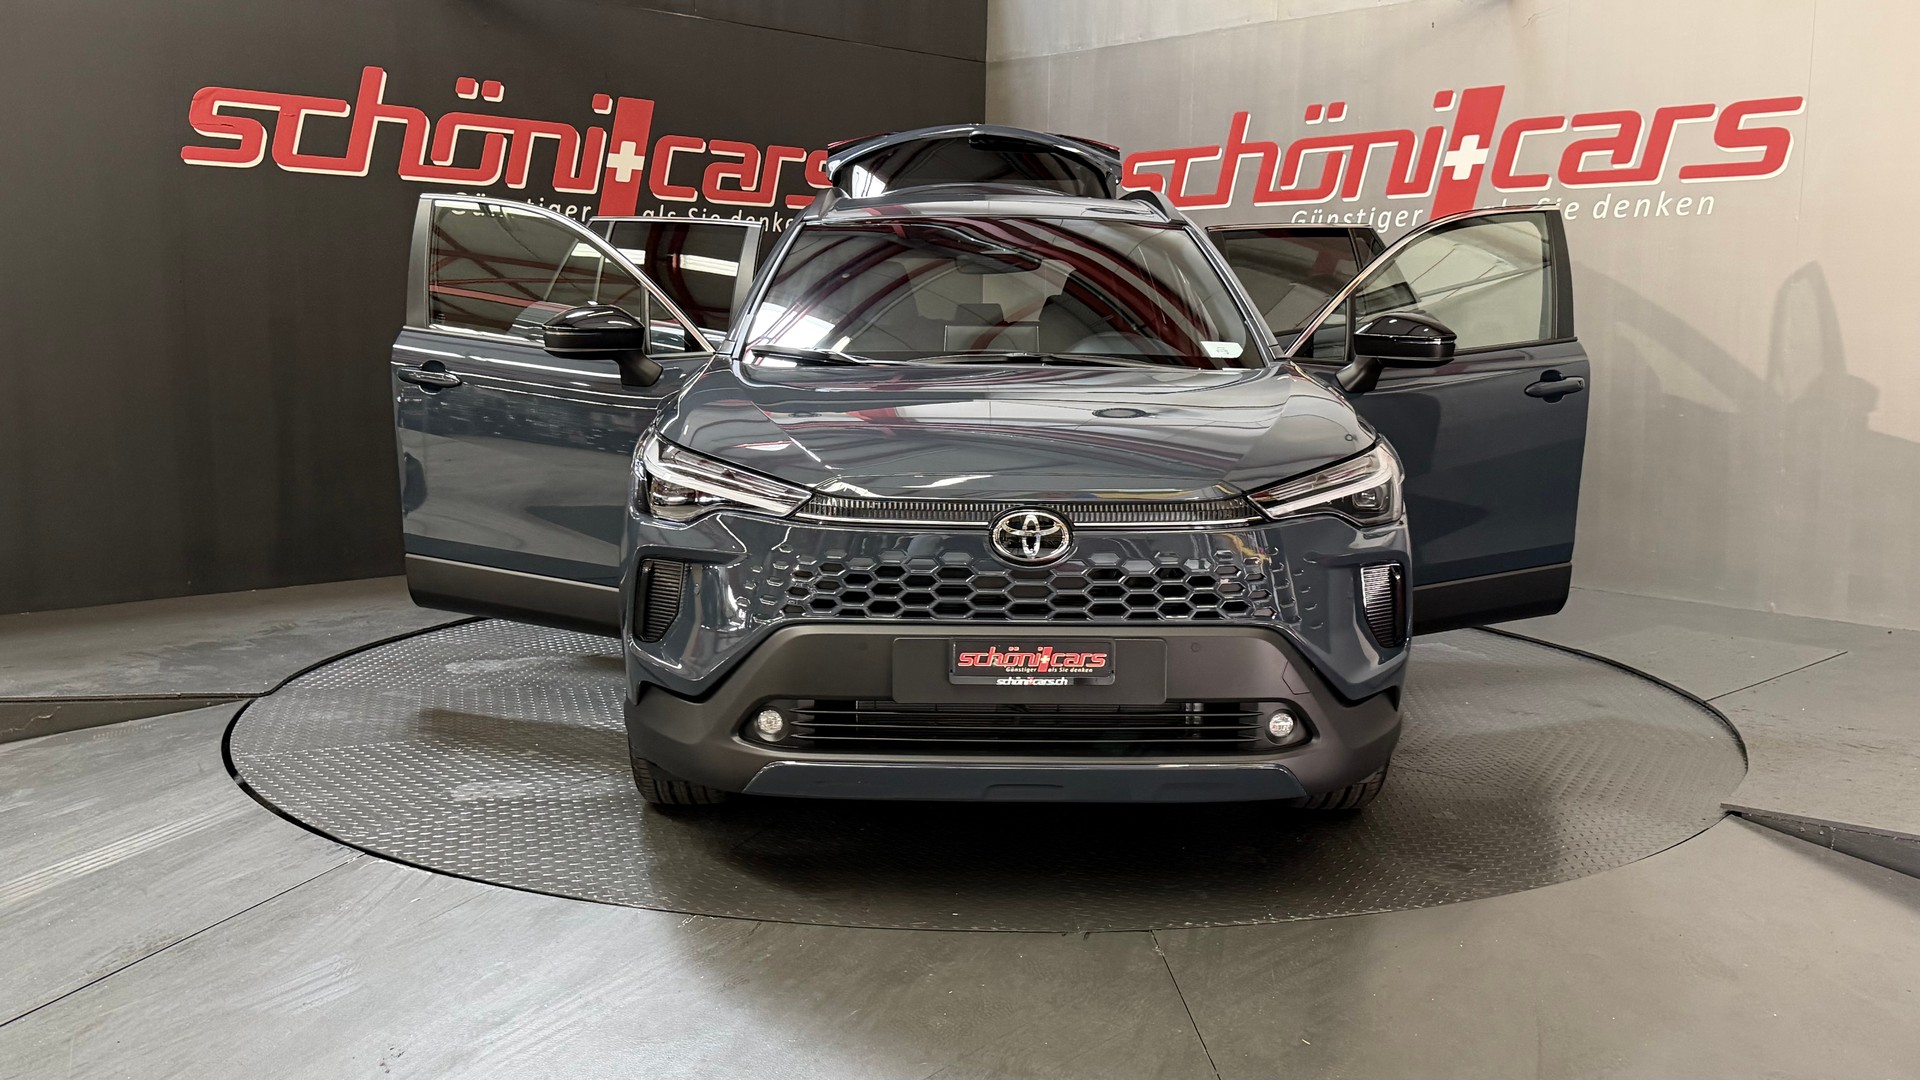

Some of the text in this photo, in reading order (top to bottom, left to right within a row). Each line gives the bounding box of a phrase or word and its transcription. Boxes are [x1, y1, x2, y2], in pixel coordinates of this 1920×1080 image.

[1493, 95, 1804, 193] cars
[1291, 206, 1424, 234] Günstiger
[1593, 190, 1716, 220] denken
